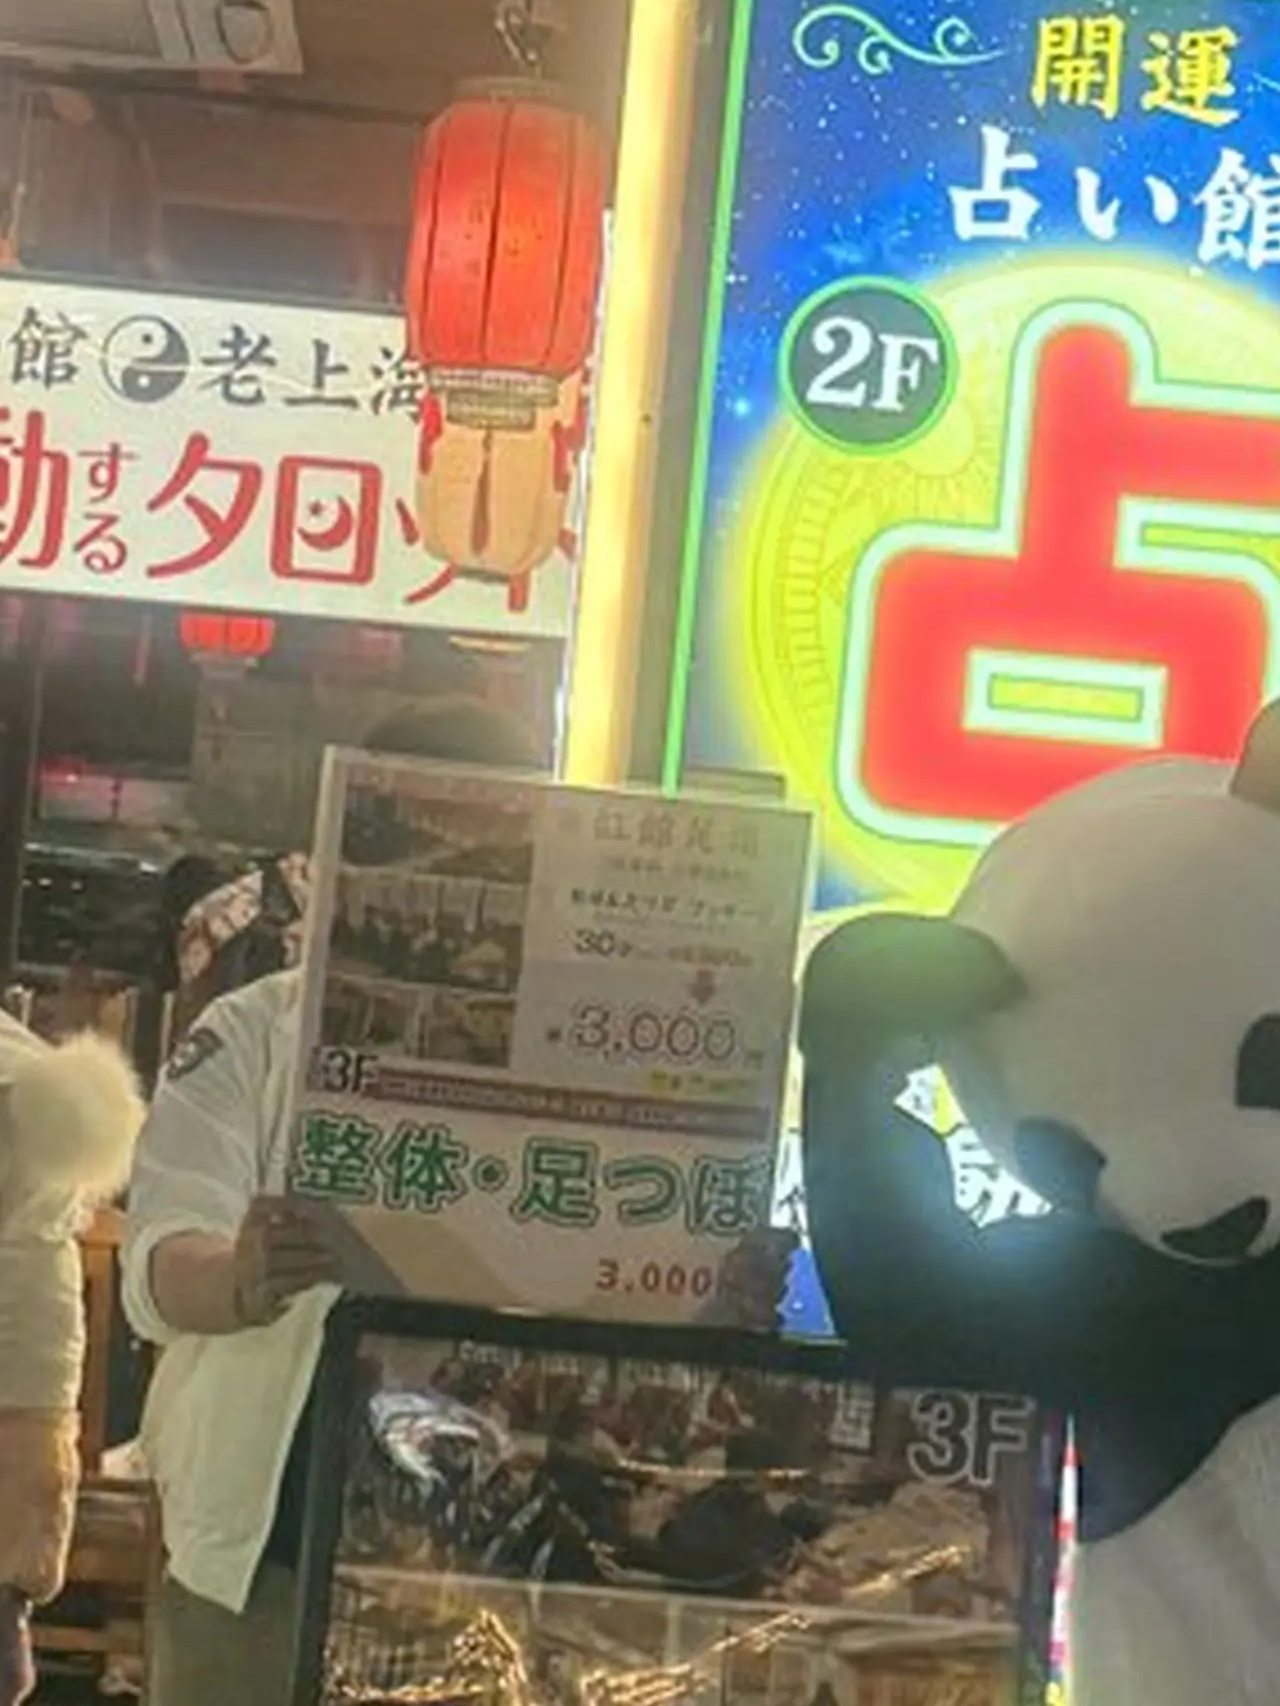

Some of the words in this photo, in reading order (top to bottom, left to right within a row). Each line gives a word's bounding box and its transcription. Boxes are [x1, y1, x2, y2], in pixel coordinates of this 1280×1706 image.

[1030, 13, 1244, 128] 開運
[806, 316, 940, 414] 2F
[322, 1050, 379, 1093] 3F
[294, 1111, 772, 1235] 整体・足つぼ
[908, 1390, 1035, 1487] 3F
